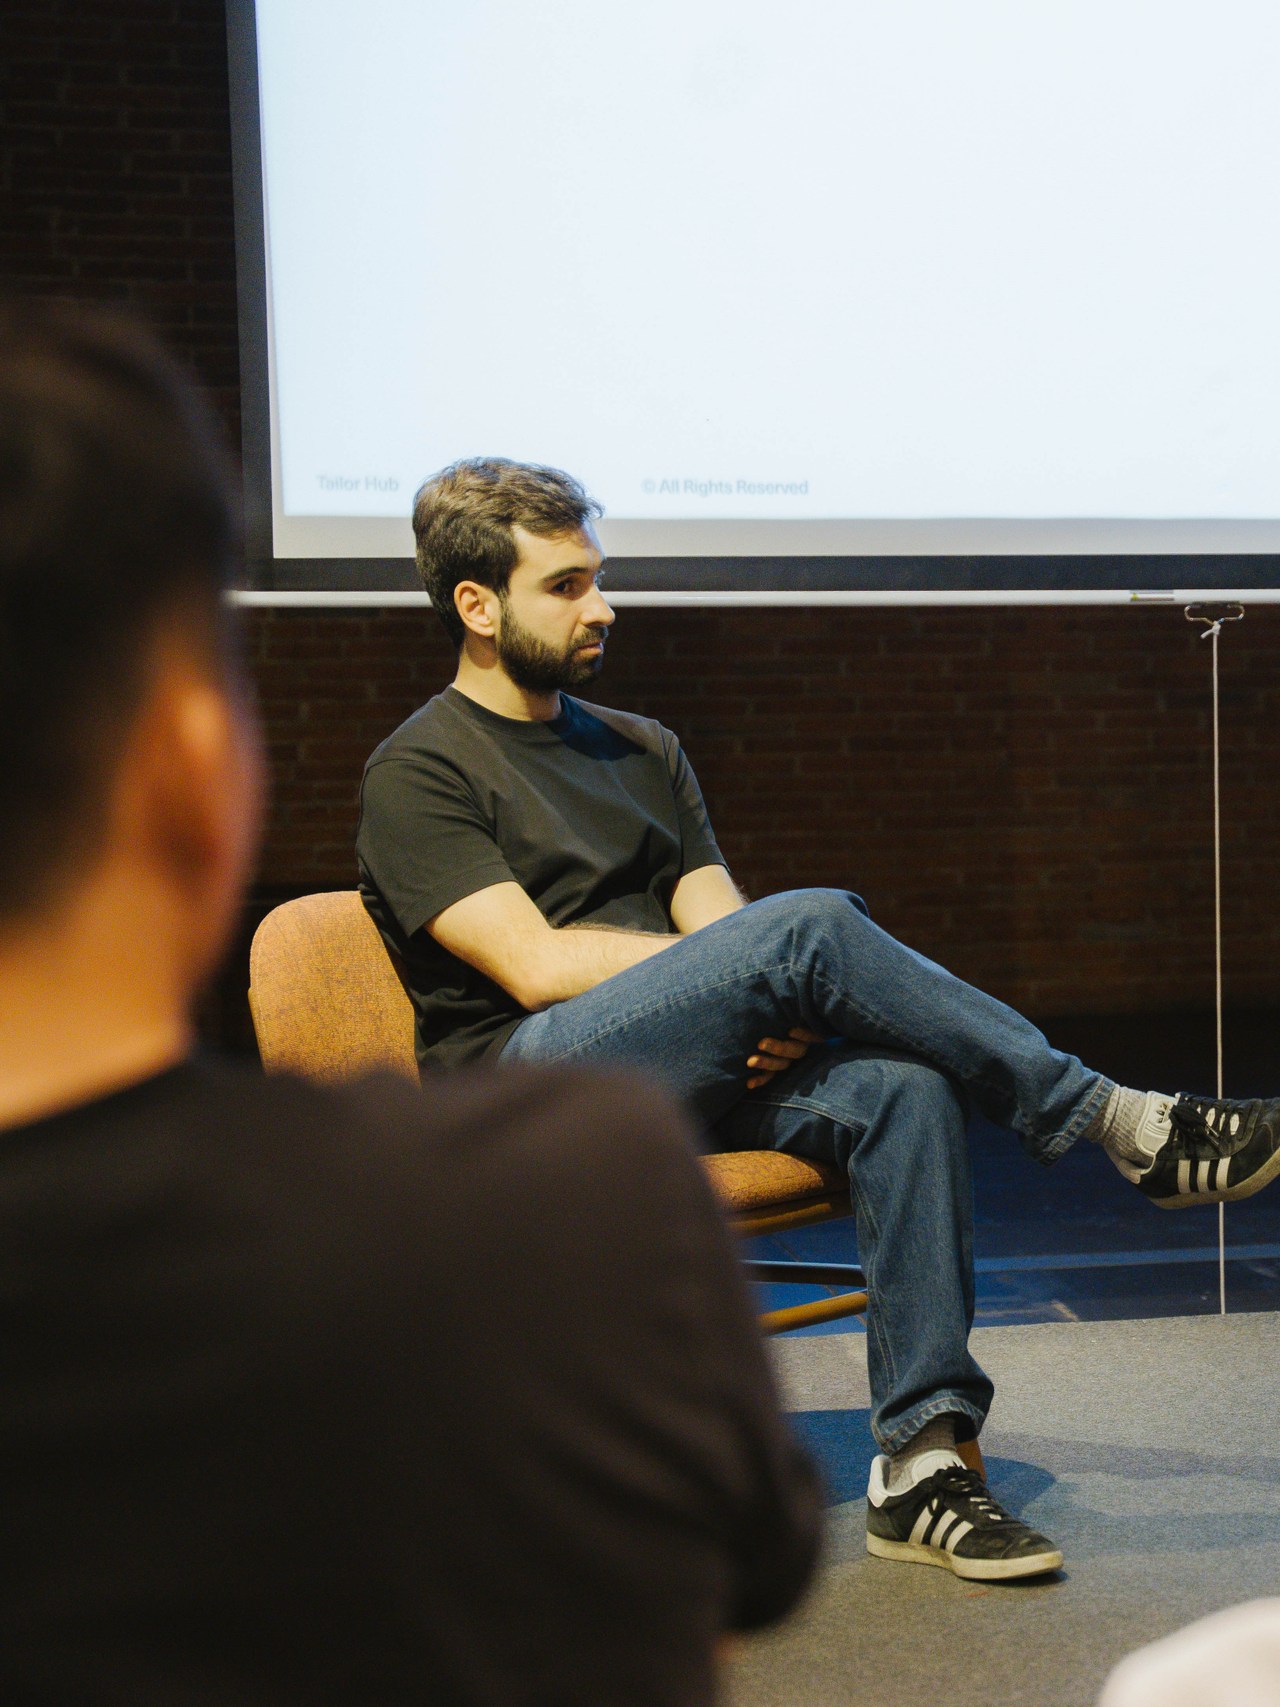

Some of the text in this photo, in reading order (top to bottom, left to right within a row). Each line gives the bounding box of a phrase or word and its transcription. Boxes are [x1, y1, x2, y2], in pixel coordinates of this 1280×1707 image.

[316, 474, 399, 491] Tailor Hub
[659, 478, 681, 495] All
[684, 478, 733, 497] Rights
[736, 479, 809, 496] Reserved
